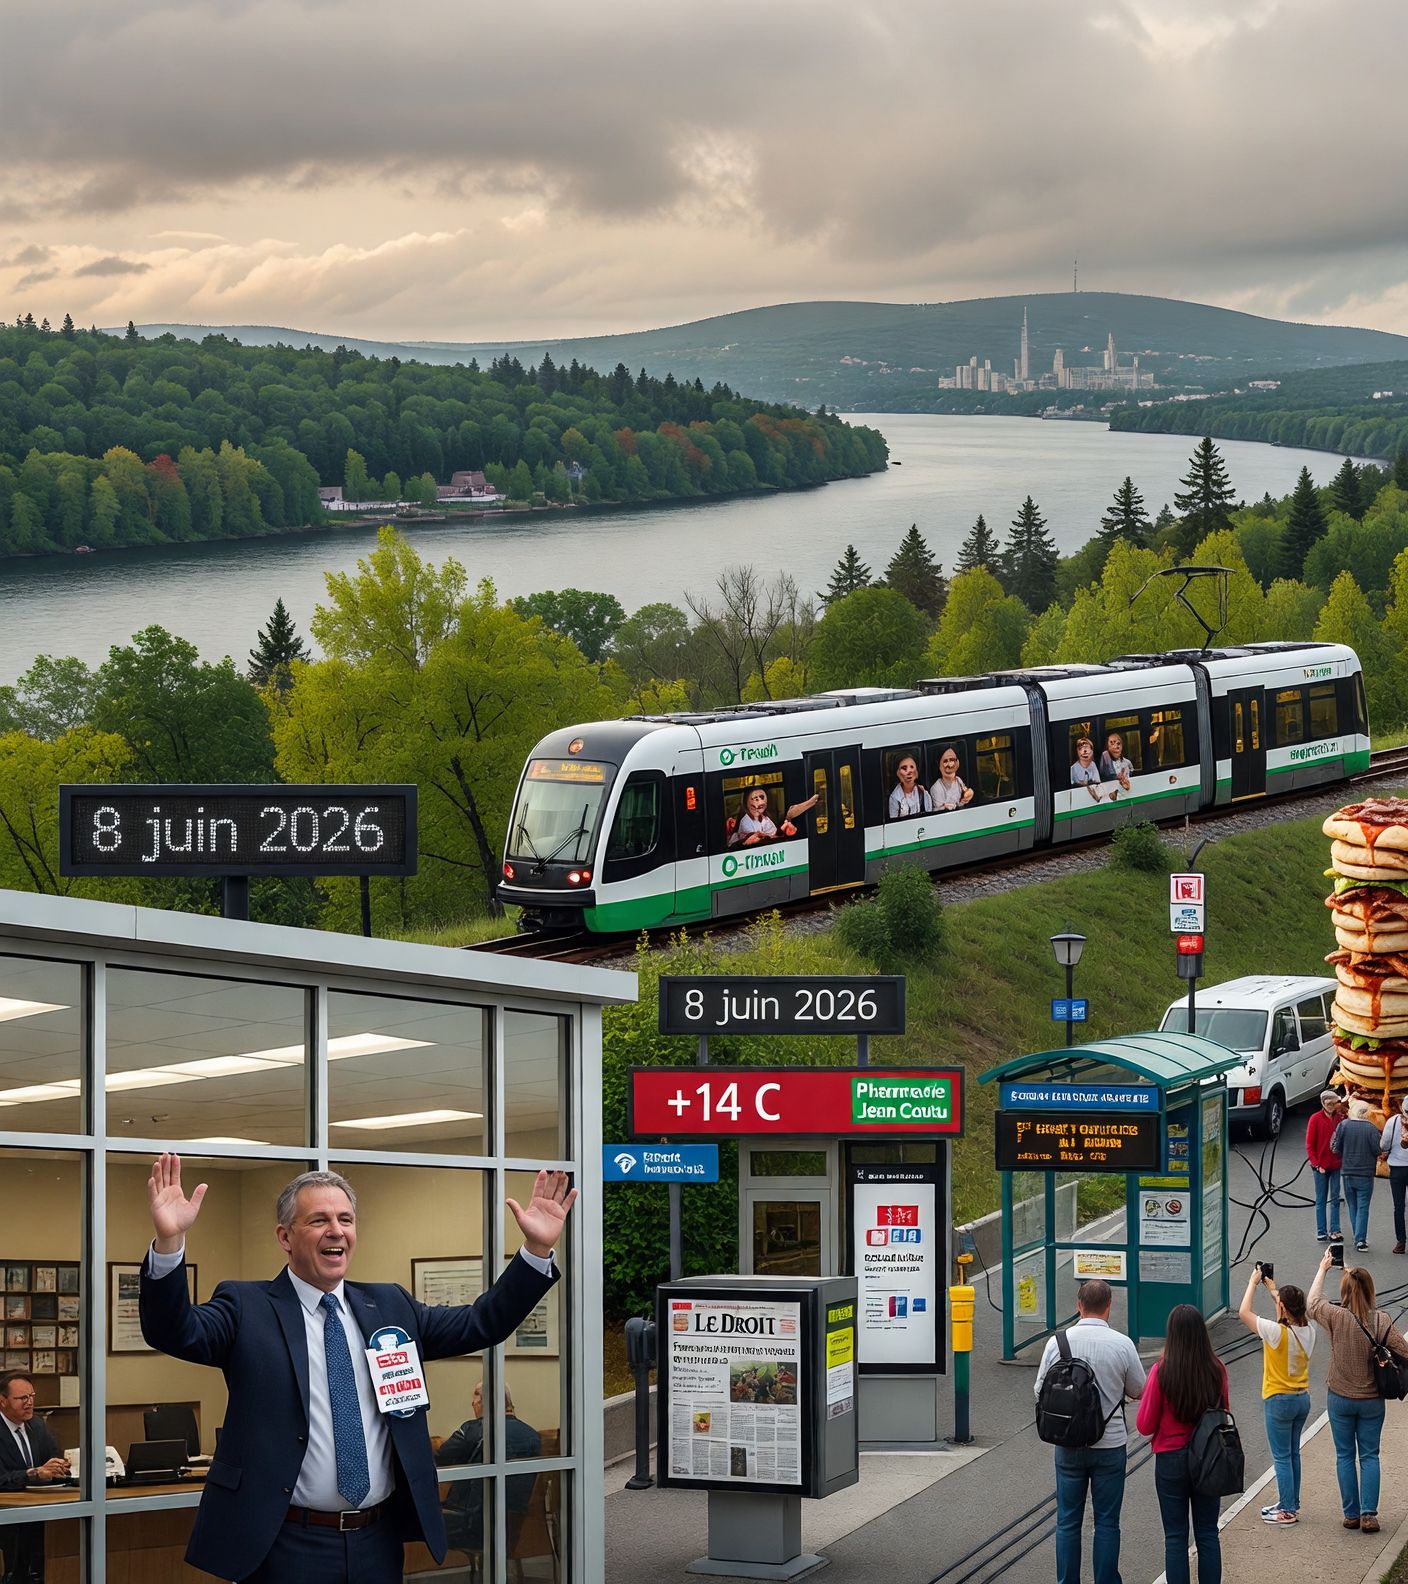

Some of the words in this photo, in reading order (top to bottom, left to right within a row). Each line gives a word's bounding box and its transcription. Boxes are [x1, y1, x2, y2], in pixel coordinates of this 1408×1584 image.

[92, 806, 122, 851] 8
[141, 806, 237, 863] juin
[259, 806, 384, 852] 2026
[684, 989, 704, 1020] 8
[715, 988, 780, 1026] juin
[794, 989, 878, 1021] 2026
[667, 1082, 742, 1122] +14
[754, 1082, 781, 1122] C
[856, 1102, 897, 1119] Jean
[720, 1313, 777, 1336] DROIT
